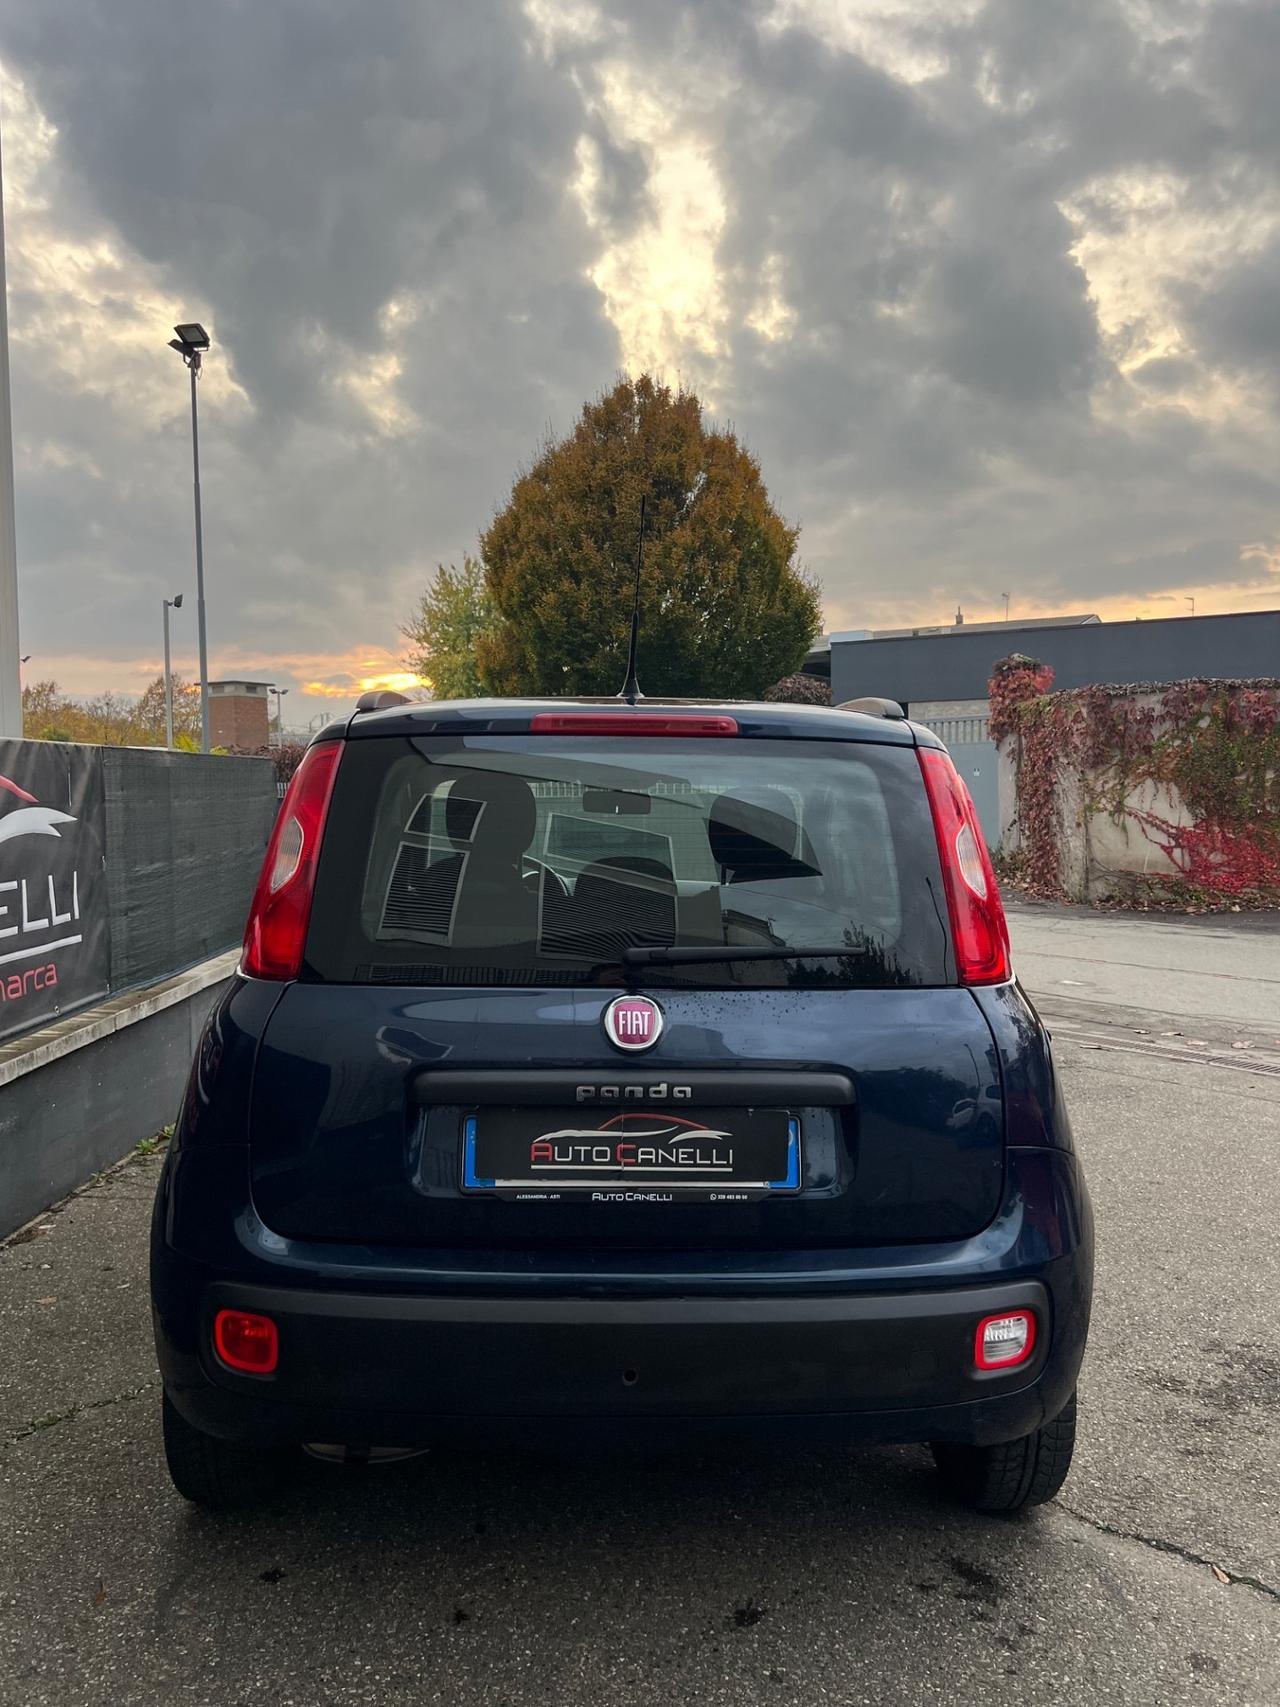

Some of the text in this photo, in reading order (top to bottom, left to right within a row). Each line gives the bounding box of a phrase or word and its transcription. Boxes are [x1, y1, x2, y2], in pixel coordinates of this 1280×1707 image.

[0, 963, 58, 1001] arca
[618, 1010, 651, 1036] FIAT
[576, 1082, 692, 1102] panda
[531, 1143, 733, 1165] AUTO CANELLI
